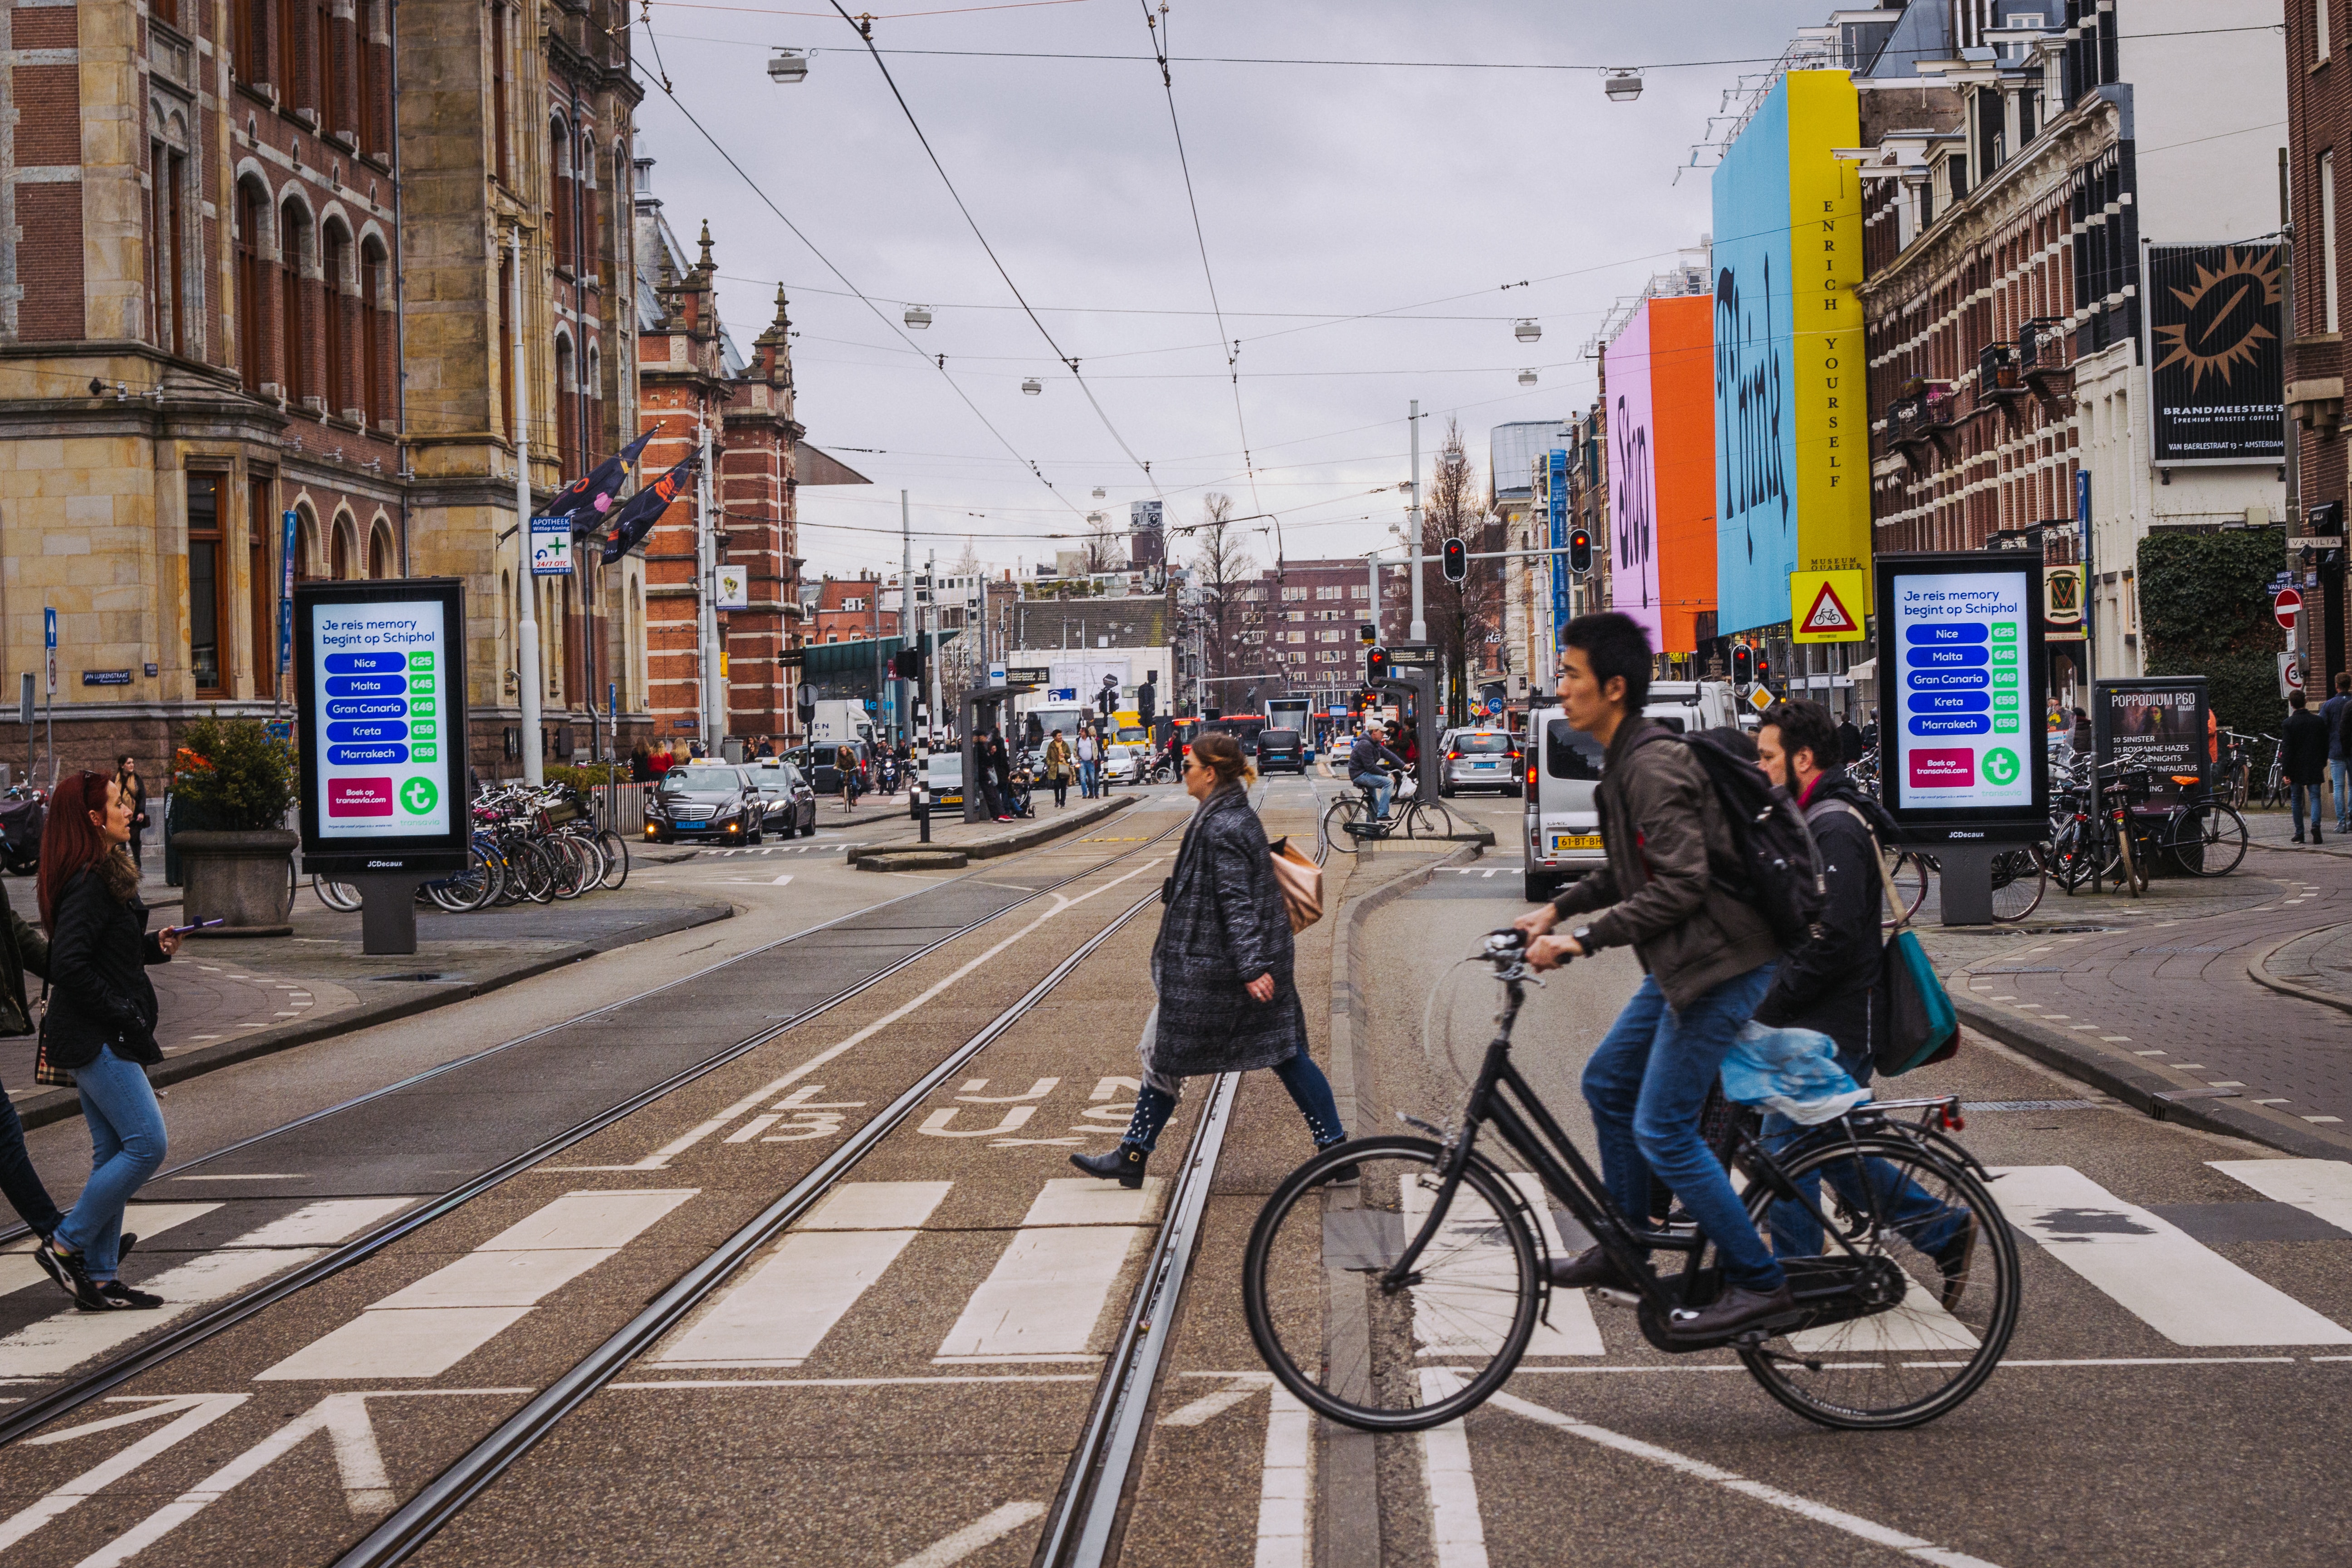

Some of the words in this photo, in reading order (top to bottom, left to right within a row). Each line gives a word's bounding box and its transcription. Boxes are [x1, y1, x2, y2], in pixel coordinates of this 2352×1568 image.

[1823, 201, 1838, 310] ENRICH
[1824, 338, 1841, 487] YOURSELF
[2164, 404, 2284, 415] BRANDMEESTER'S
[2078, 476, 2083, 508] P
[289, 517, 294, 548] P
[1904, 592, 1921, 601] Je
[1923, 591, 1945, 601] reis
[1948, 591, 1999, 601] memory
[1905, 605, 1944, 618] begint
[1946, 607, 1962, 616] op
[1965, 603, 2017, 615] Schiphol
[322, 620, 338, 630] Je
[342, 620, 363, 630] reis
[367, 620, 416, 630] memory
[1936, 629, 1959, 639] Nice
[1994, 627, 2014, 637] €25
[323, 634, 362, 647] begint
[364, 636, 380, 646] op
[383, 632, 434, 644] Schiphol
[1933, 652, 1963, 662] Malta
[1994, 650, 2015, 660] €45
[354, 658, 377, 668] Nice
[411, 657, 431, 666] €25
[351, 681, 381, 691] Malta
[412, 679, 432, 689] €45
[1914, 675, 1940, 685] Gran
[1941, 674, 1983, 684] Canaria
[1994, 673, 2015, 682] €49
[1935, 697, 1963, 707] Kreta
[1995, 696, 2016, 705] €59
[2112, 693, 2172, 707] POPPODIUM
[2176, 693, 2195, 705] P60
[333, 704, 358, 714] Gran
[360, 702, 401, 714] Canaria
[412, 702, 433, 711] €49
[1922, 720, 1977, 730] Marrakech
[1996, 718, 2017, 728] €59
[353, 726, 382, 736] Kreta
[413, 725, 434, 734] €59
[341, 749, 395, 759] Marrakech
[413, 747, 434, 757] €59
[346, 789, 363, 797] Boek
